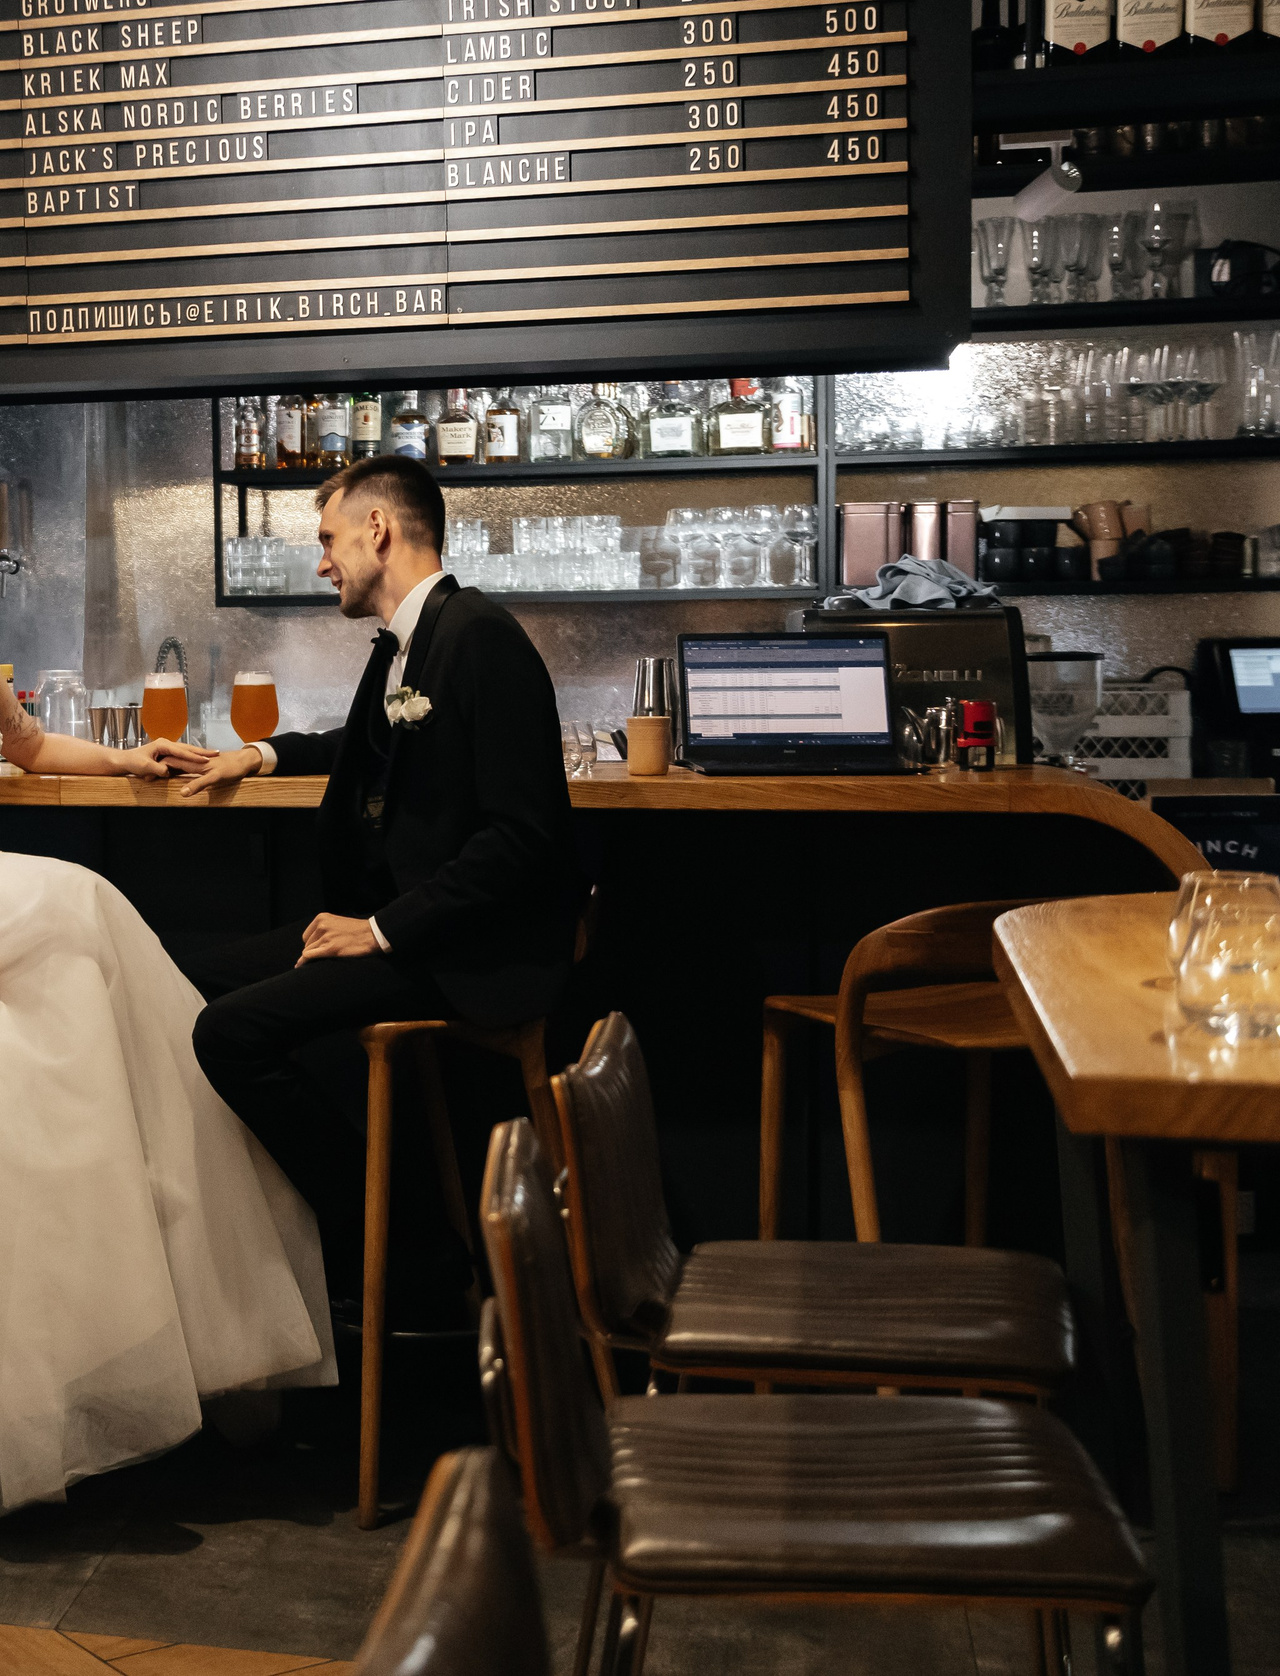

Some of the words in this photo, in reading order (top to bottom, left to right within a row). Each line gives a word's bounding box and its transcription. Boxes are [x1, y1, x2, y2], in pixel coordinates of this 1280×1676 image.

[449, 0, 529, 21] IRISH
[826, 7, 876, 33] 500
[24, 28, 99, 56] BLACK
[121, 20, 197, 47] SHEEP
[684, 19, 732, 44] 300
[447, 32, 547, 63] LAMBIC
[685, 61, 733, 87] 250
[828, 50, 878, 77] 450
[25, 68, 100, 96] KRIEK
[121, 63, 167, 88] MAX
[447, 75, 530, 103] CIDER
[26, 108, 102, 135] ALSKA
[124, 99, 217, 128] NORDIC
[241, 88, 353, 119] BERRIES
[689, 103, 737, 129] 300
[827, 94, 877, 119] 450
[451, 120, 494, 145] IPA
[136, 135, 263, 166] PRECIOUS
[690, 145, 739, 171] 250
[827, 136, 879, 162] 450
[448, 157, 565, 187] BLANCHE
[28, 185, 135, 213] BAPTIST
